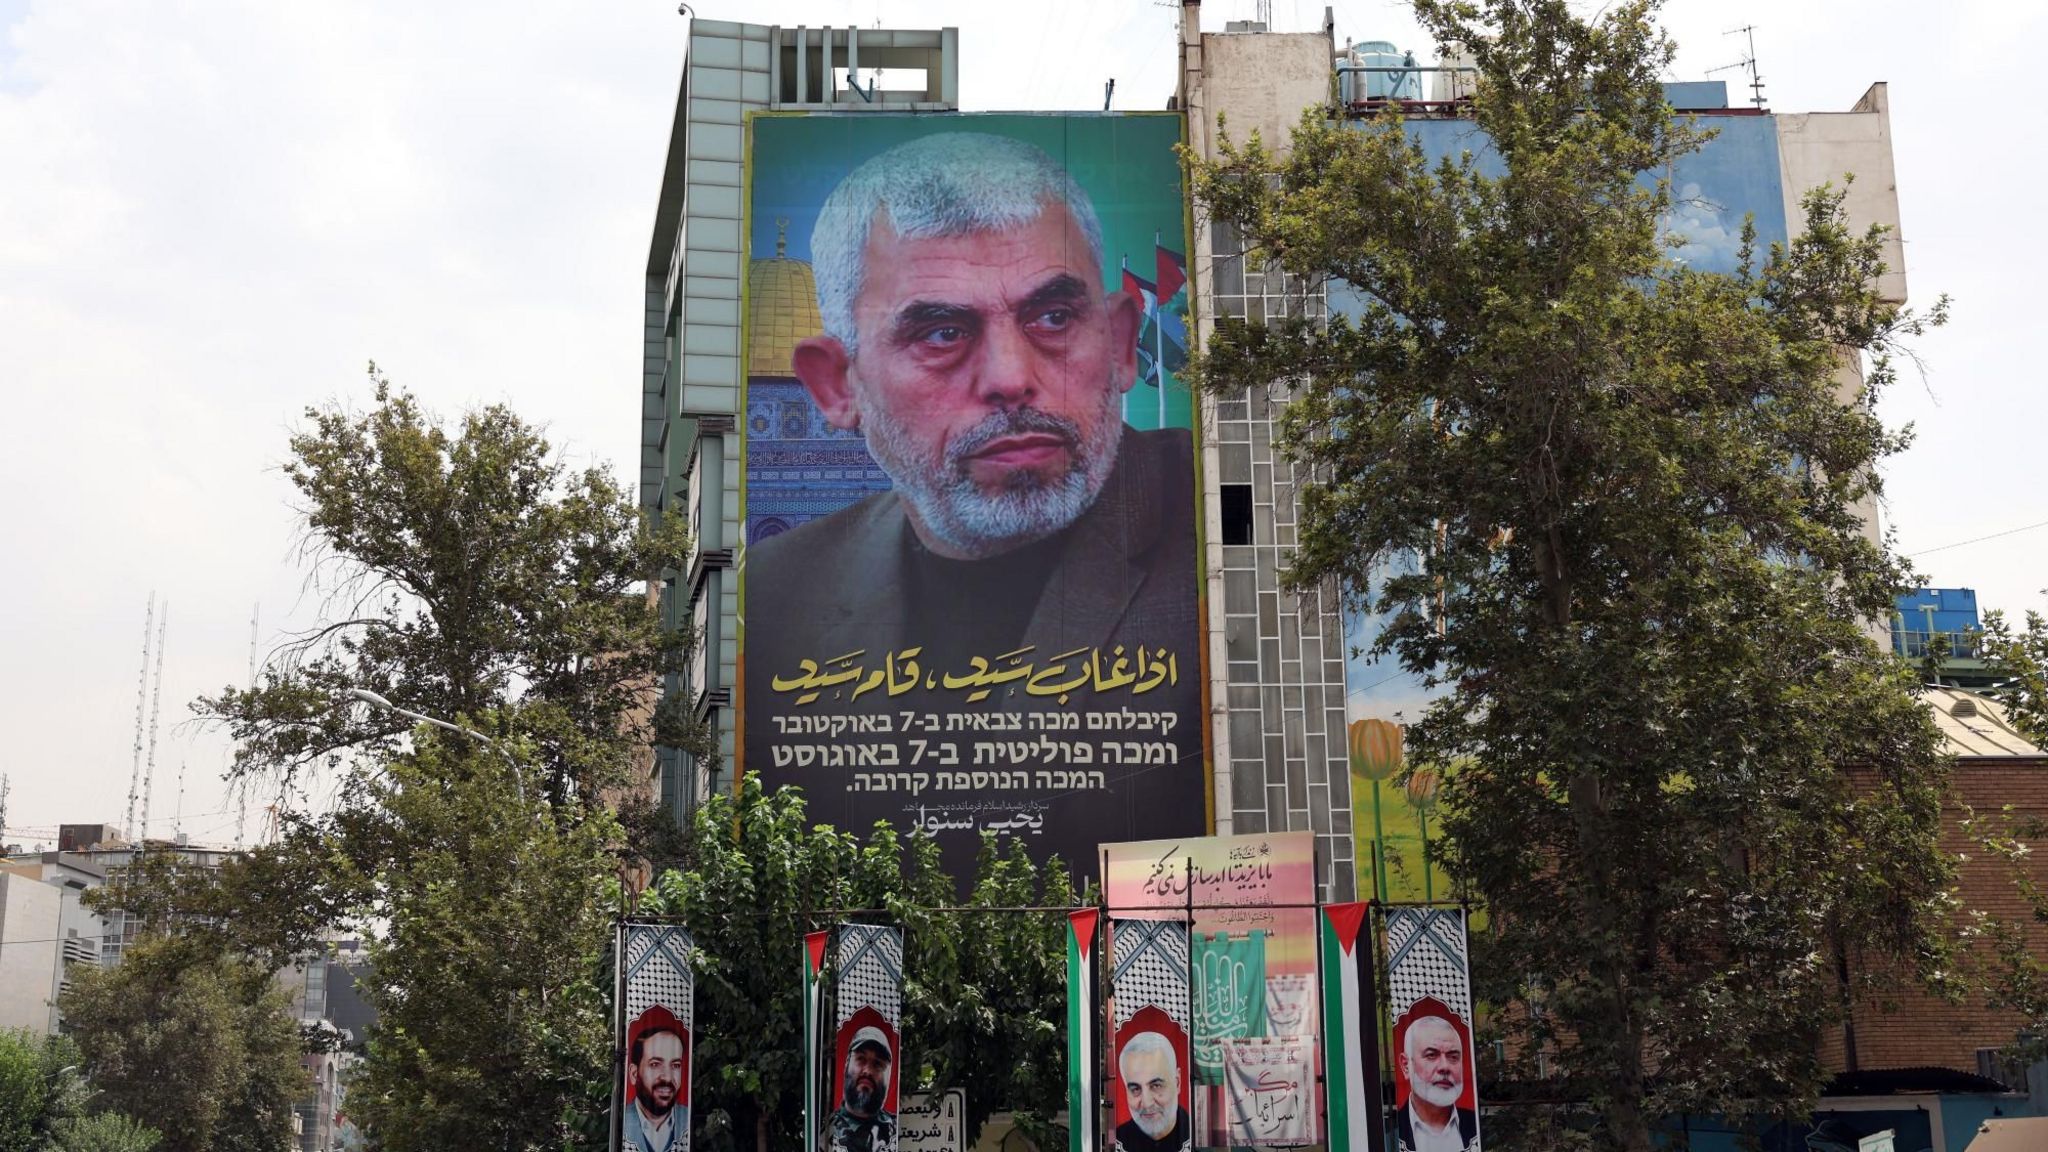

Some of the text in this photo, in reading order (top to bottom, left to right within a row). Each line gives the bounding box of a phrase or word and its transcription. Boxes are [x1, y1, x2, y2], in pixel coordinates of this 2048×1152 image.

[771, 706, 1178, 738] קיבלתם מכה צבאית ב-7 באוקטובר
[771, 734, 1178, 767] ומכה פוליטית ב-7 באוגוסט
[846, 770, 1105, 796] המכה הנוספת קרובה.
